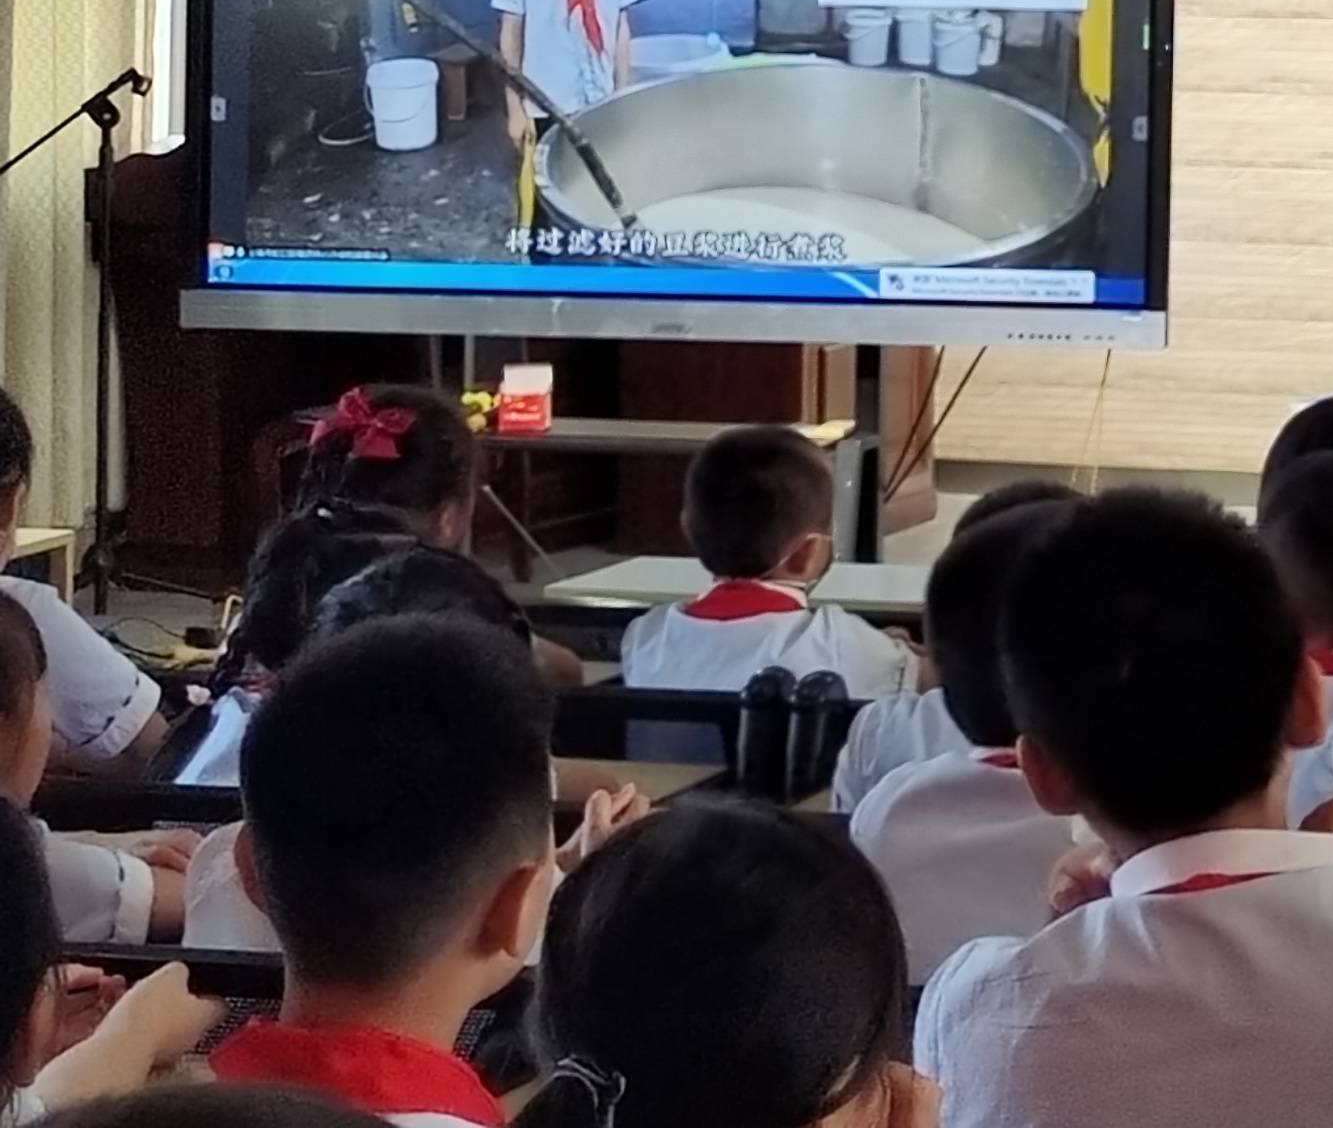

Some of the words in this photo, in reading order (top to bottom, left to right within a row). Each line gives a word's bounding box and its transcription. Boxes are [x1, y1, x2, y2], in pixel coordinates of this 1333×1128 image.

[505, 226, 848, 262] 将过滤好的豆浆进行煮浆
